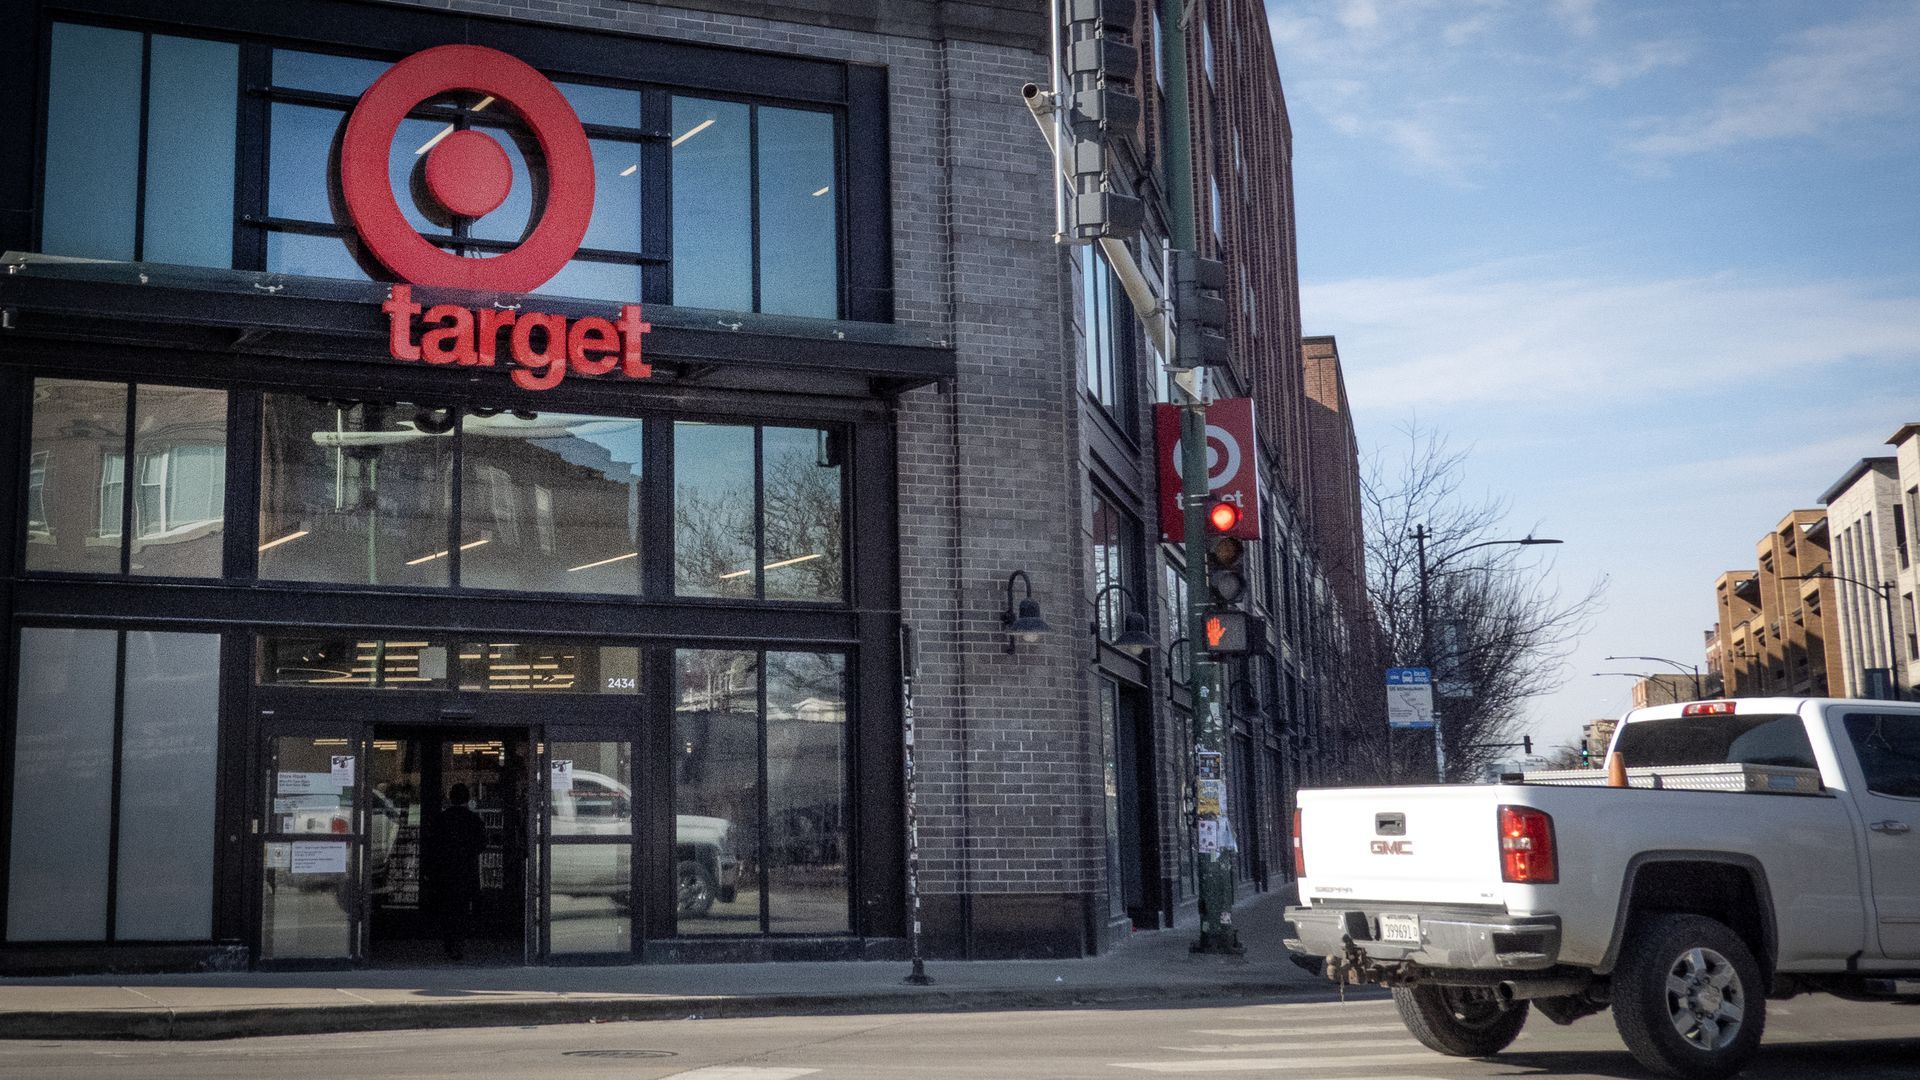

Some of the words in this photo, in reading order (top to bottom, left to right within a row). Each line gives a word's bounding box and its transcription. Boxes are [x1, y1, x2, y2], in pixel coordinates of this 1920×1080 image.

[382, 283, 651, 390] target
[1175, 490, 1243, 510] tet
[608, 678, 635, 688] 2434
[1370, 840, 1413, 855] GMC
